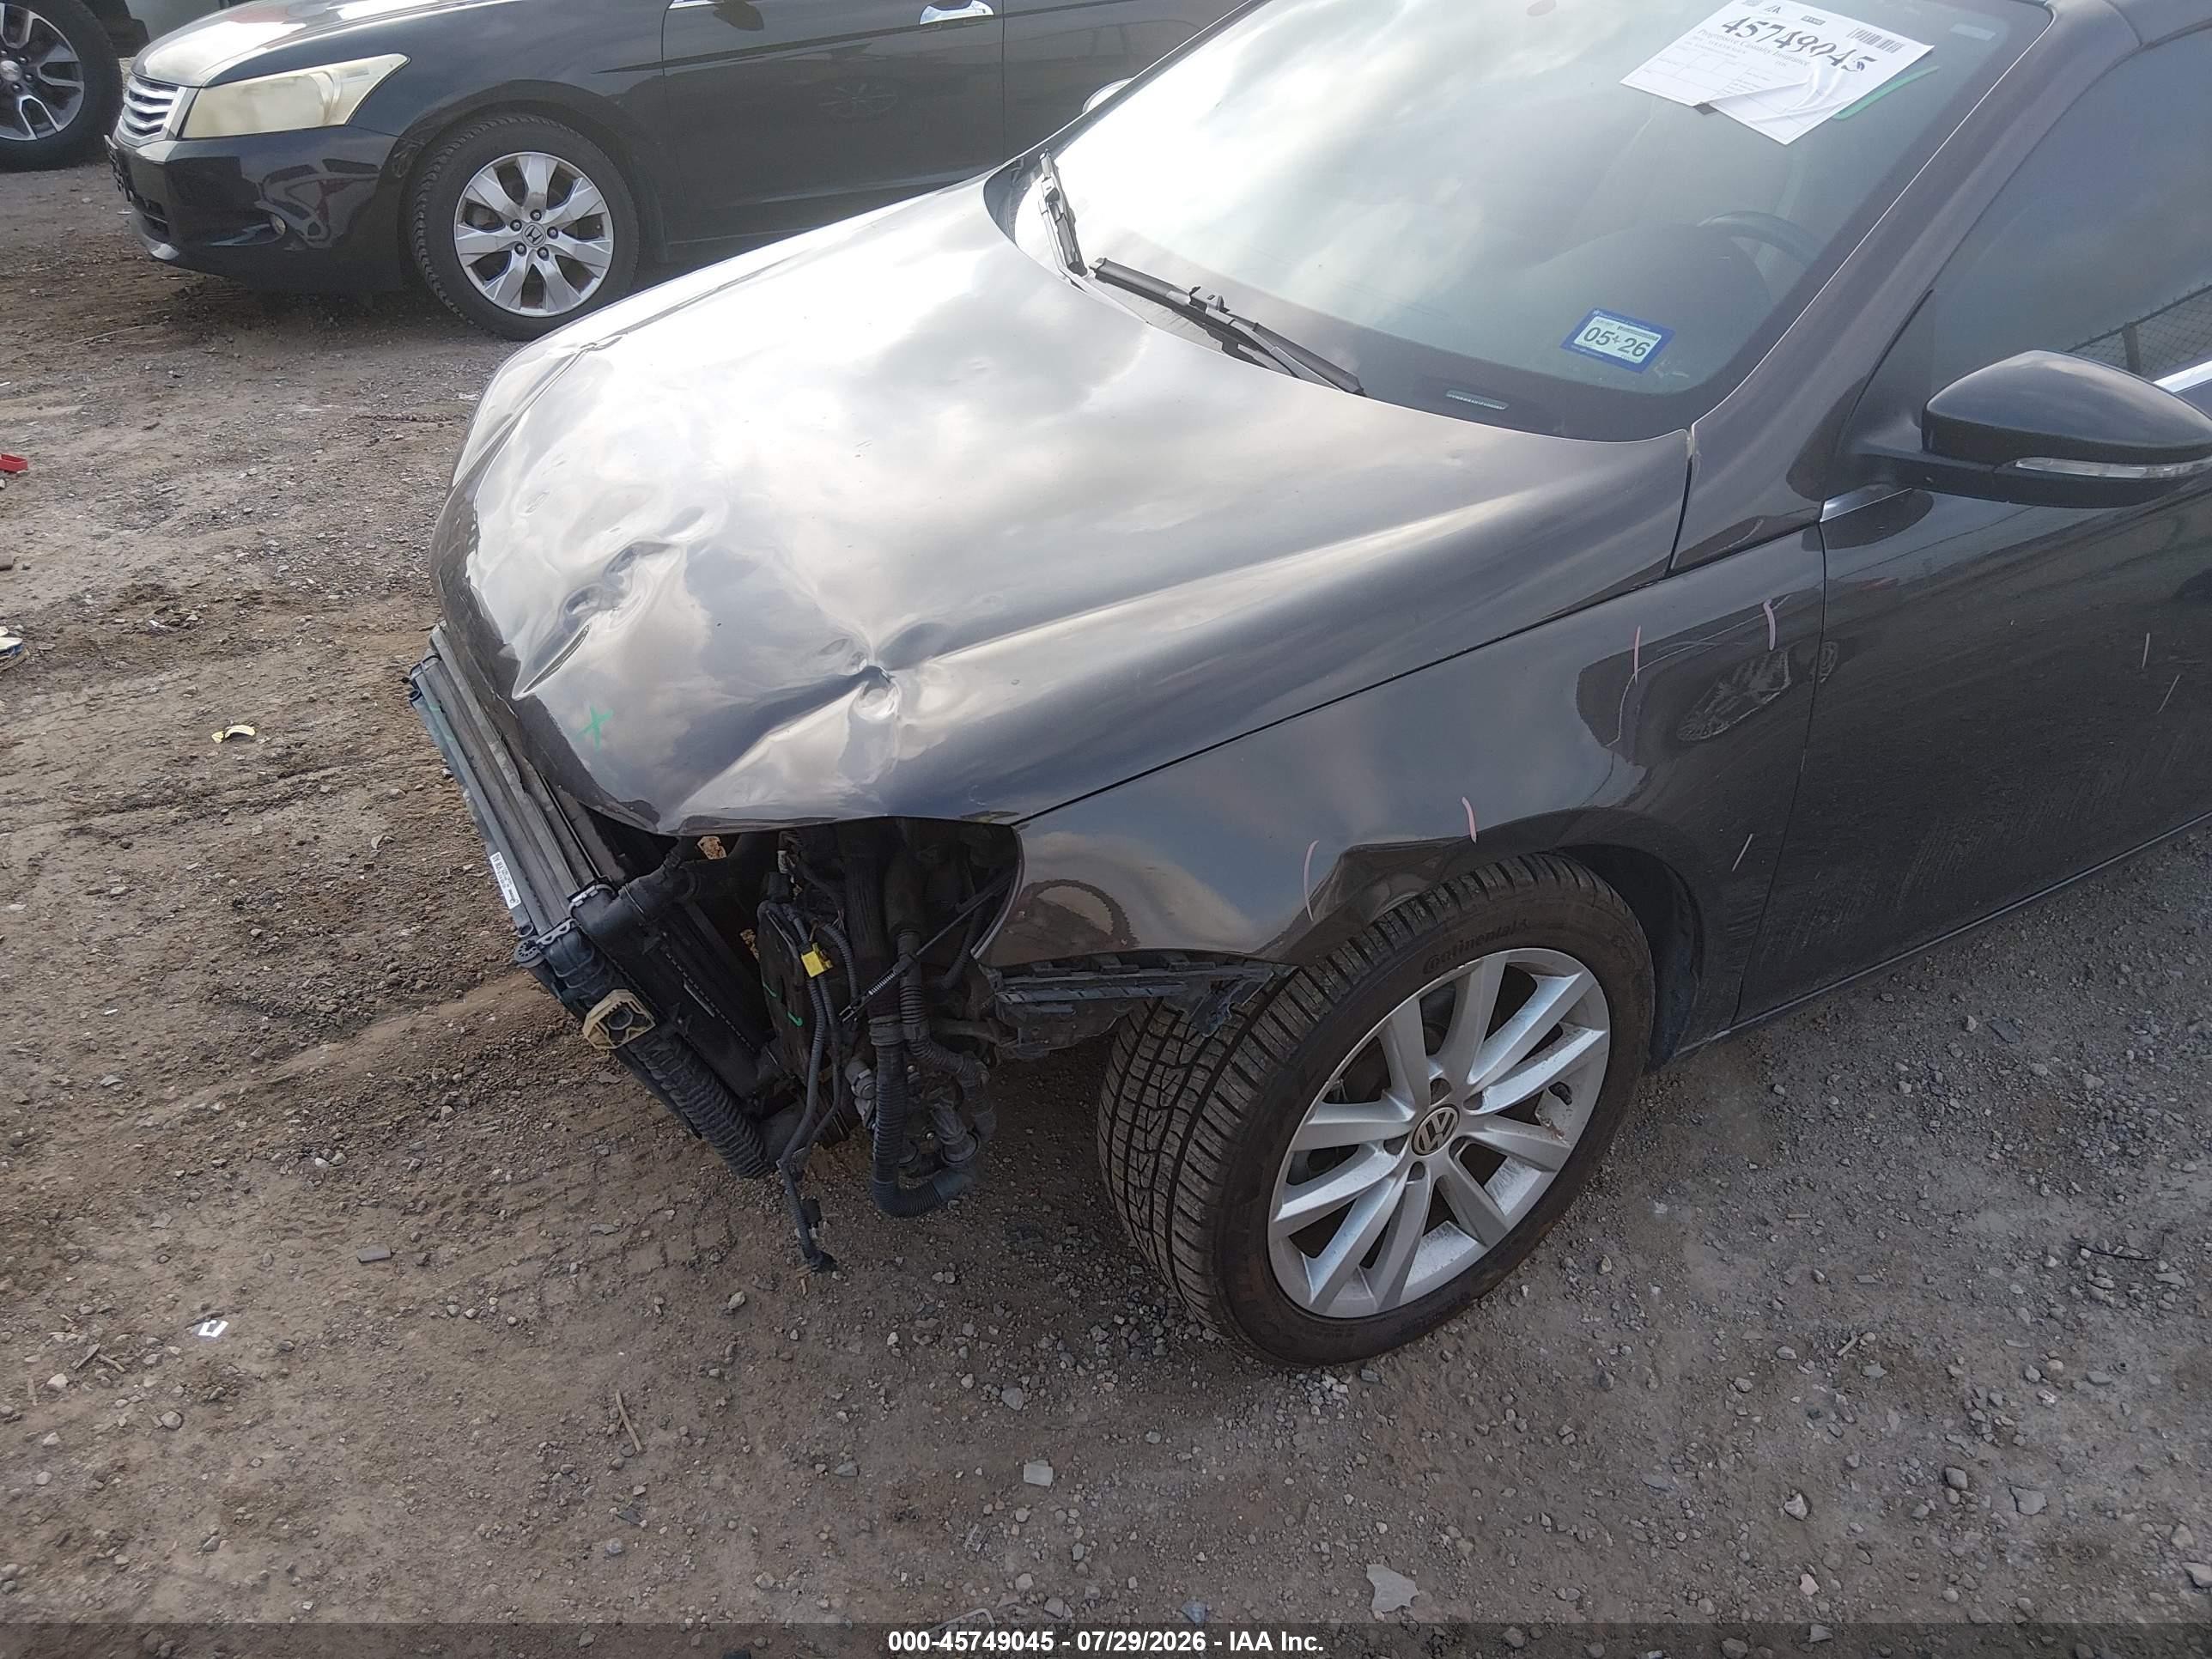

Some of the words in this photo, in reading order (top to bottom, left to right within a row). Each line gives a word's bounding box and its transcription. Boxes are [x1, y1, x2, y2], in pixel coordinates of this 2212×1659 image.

[1721, 16, 1879, 72] 45749045
[1583, 326, 1616, 346] 05
[1617, 337, 1650, 357] 26
